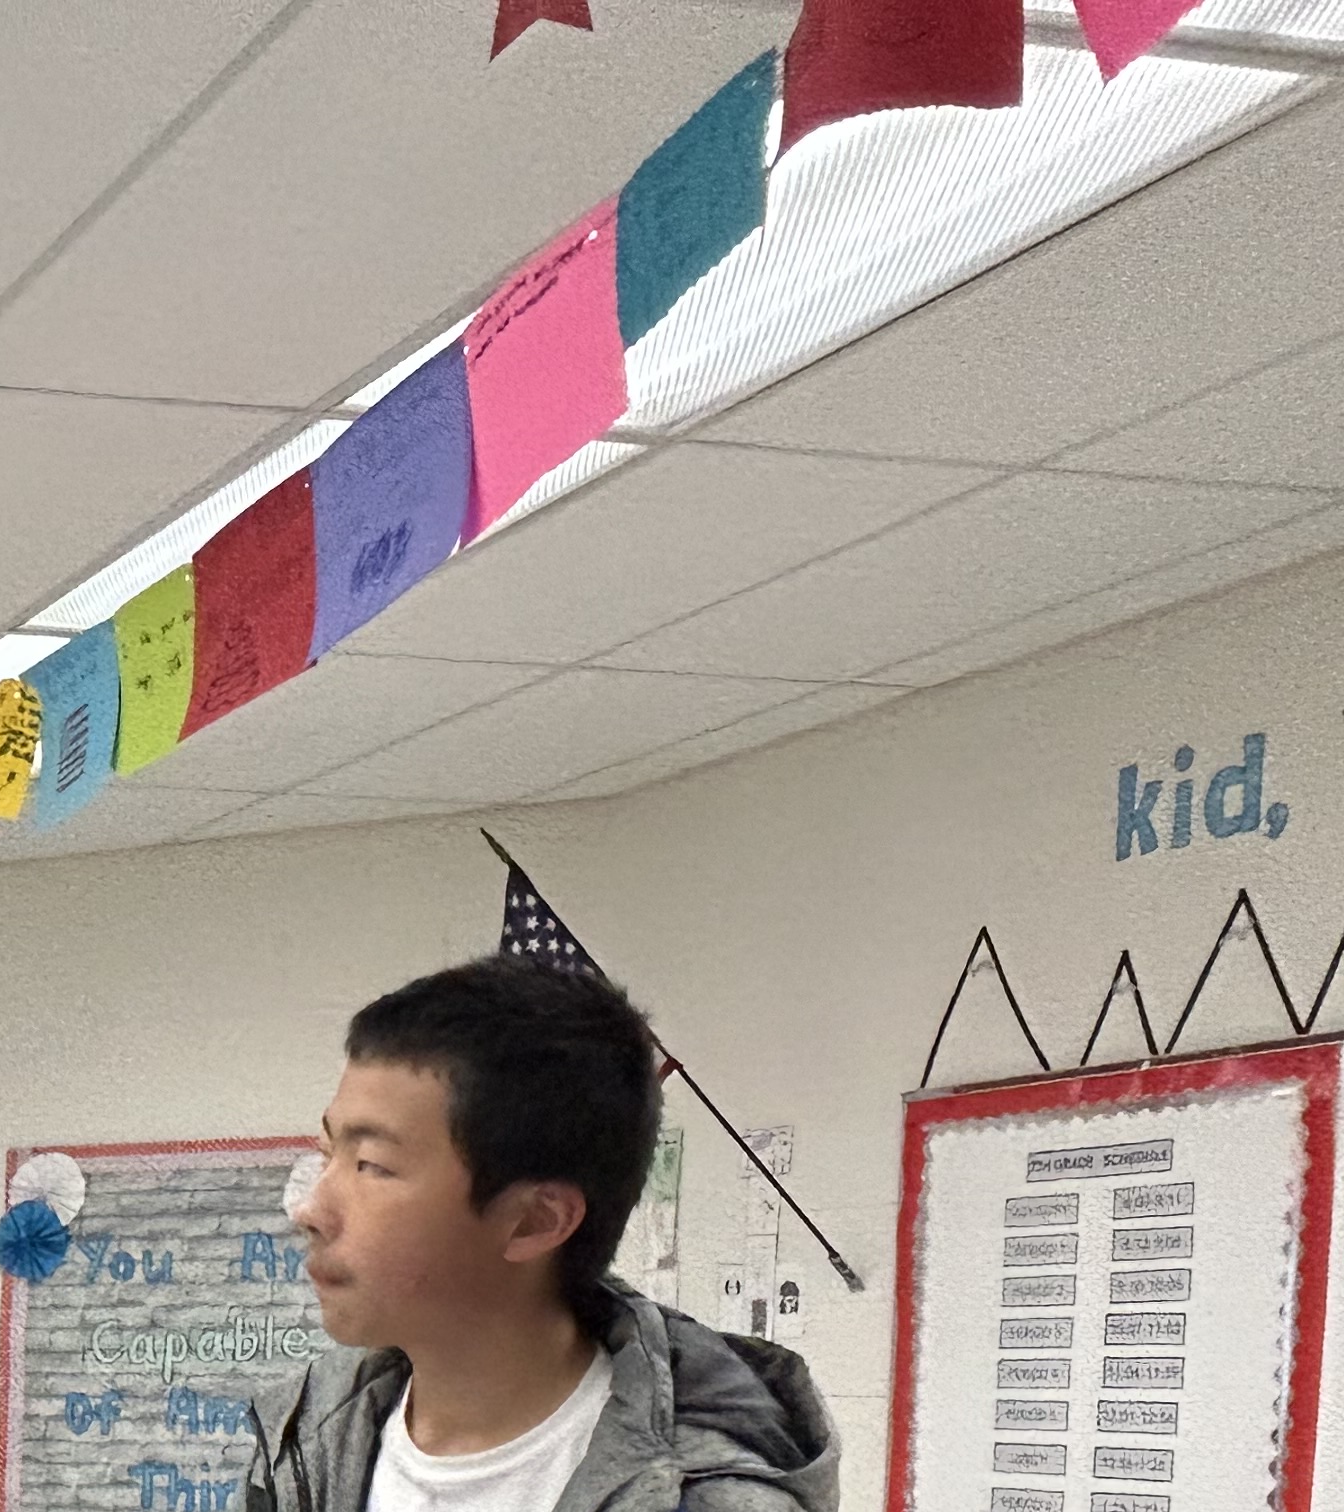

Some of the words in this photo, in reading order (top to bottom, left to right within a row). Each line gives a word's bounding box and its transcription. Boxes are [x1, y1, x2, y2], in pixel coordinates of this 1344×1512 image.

[1115, 732, 1289, 862] kid,
[76, 1234, 173, 1285] You
[90, 1314, 316, 1385] Capable
